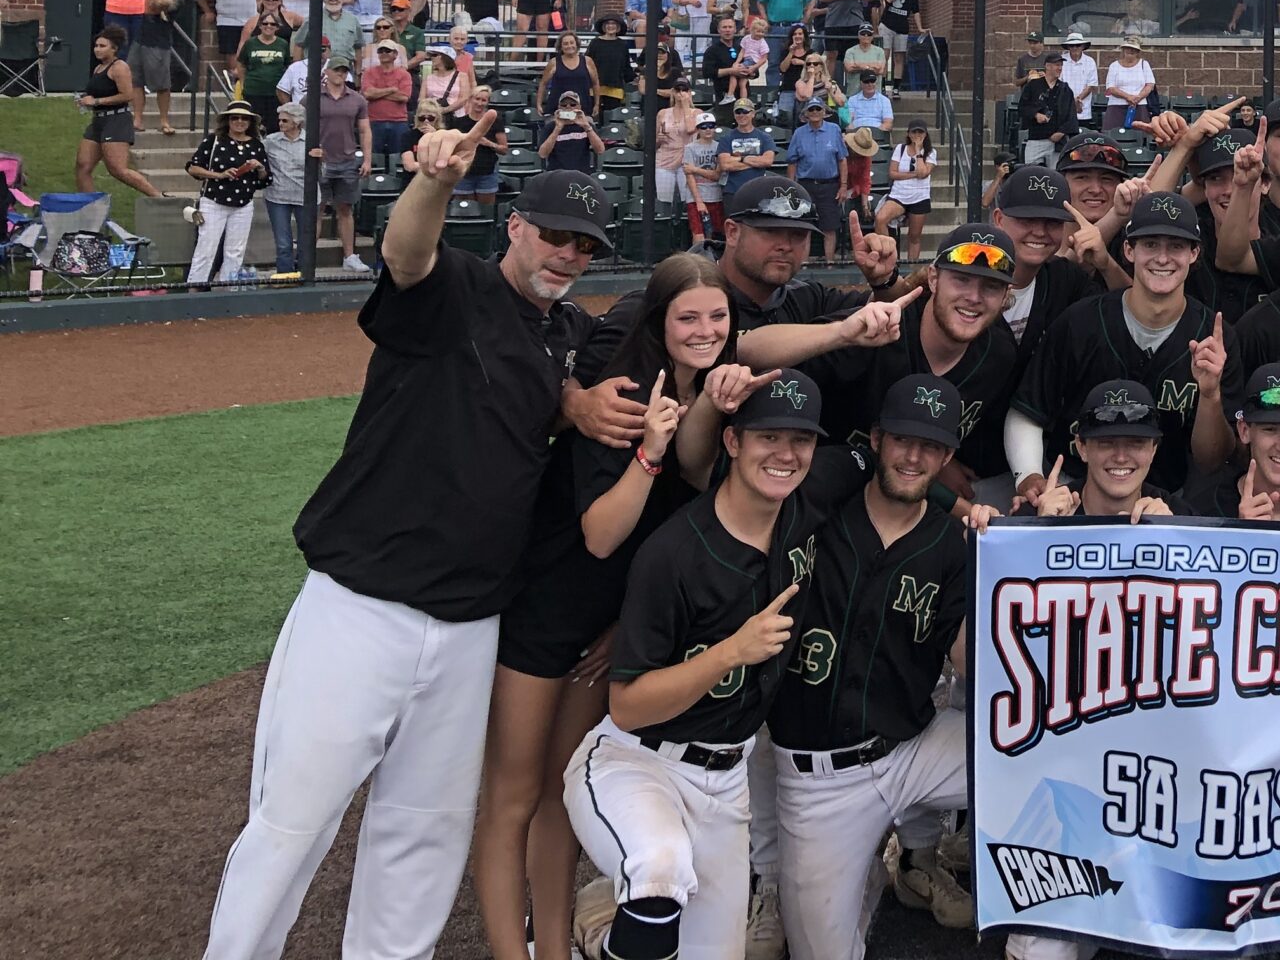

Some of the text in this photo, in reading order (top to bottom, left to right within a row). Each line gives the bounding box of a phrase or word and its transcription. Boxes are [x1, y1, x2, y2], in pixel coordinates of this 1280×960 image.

[1046, 543, 1279, 575] COLORADO
[990, 575, 1222, 757] STATE
[997, 846, 1091, 907] CHSAA
